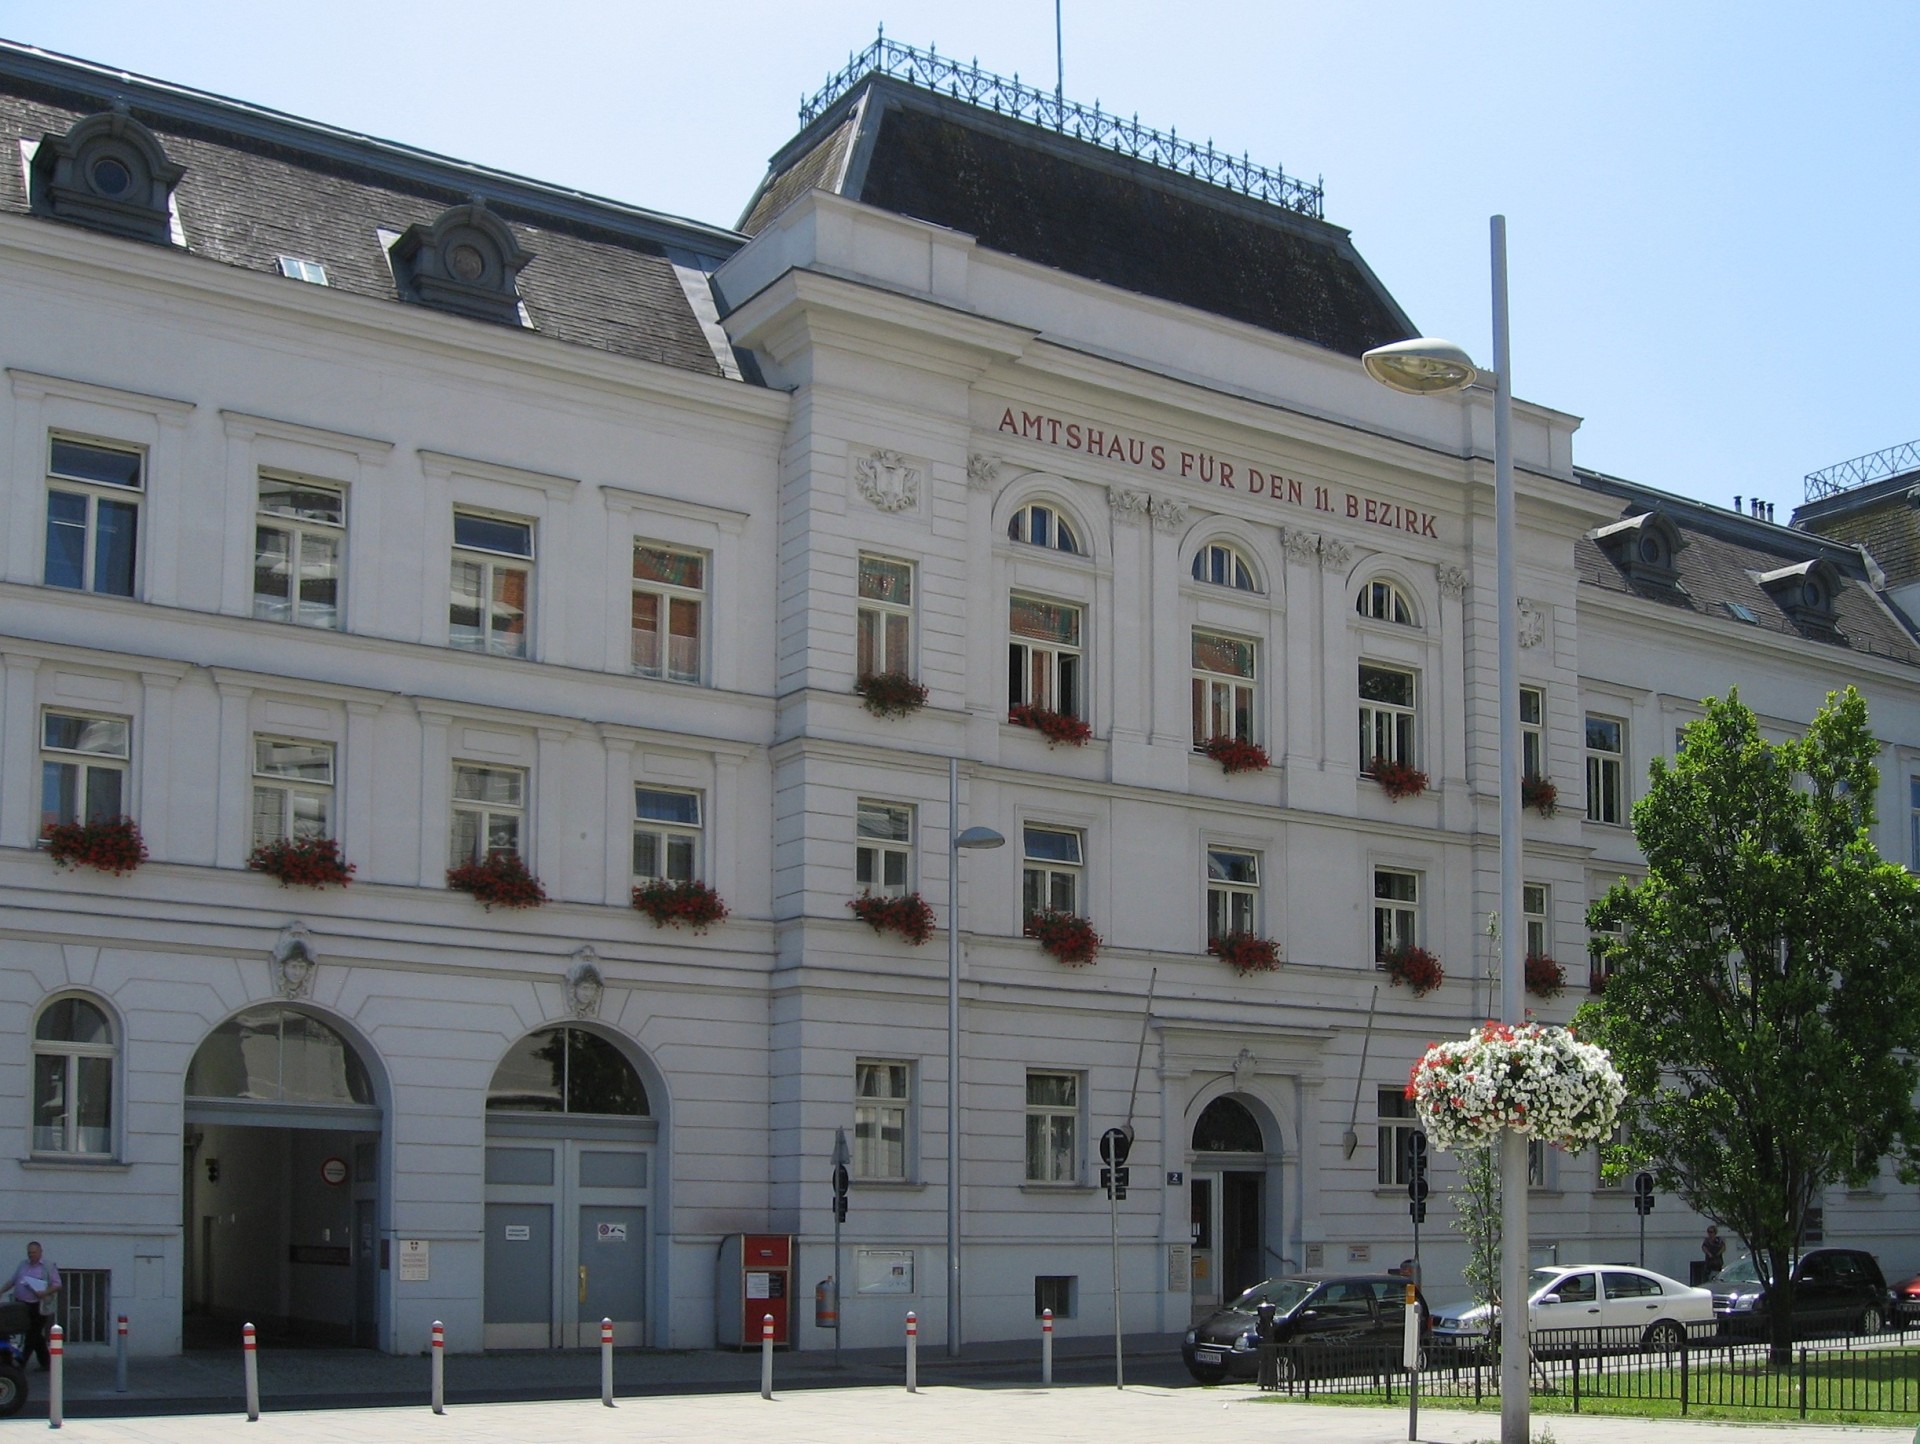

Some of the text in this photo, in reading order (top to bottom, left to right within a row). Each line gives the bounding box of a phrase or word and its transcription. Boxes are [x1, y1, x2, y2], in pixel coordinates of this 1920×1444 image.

[999, 407, 1438, 539] AMTSHAUS FÜR DEN 11. BEZIRK
